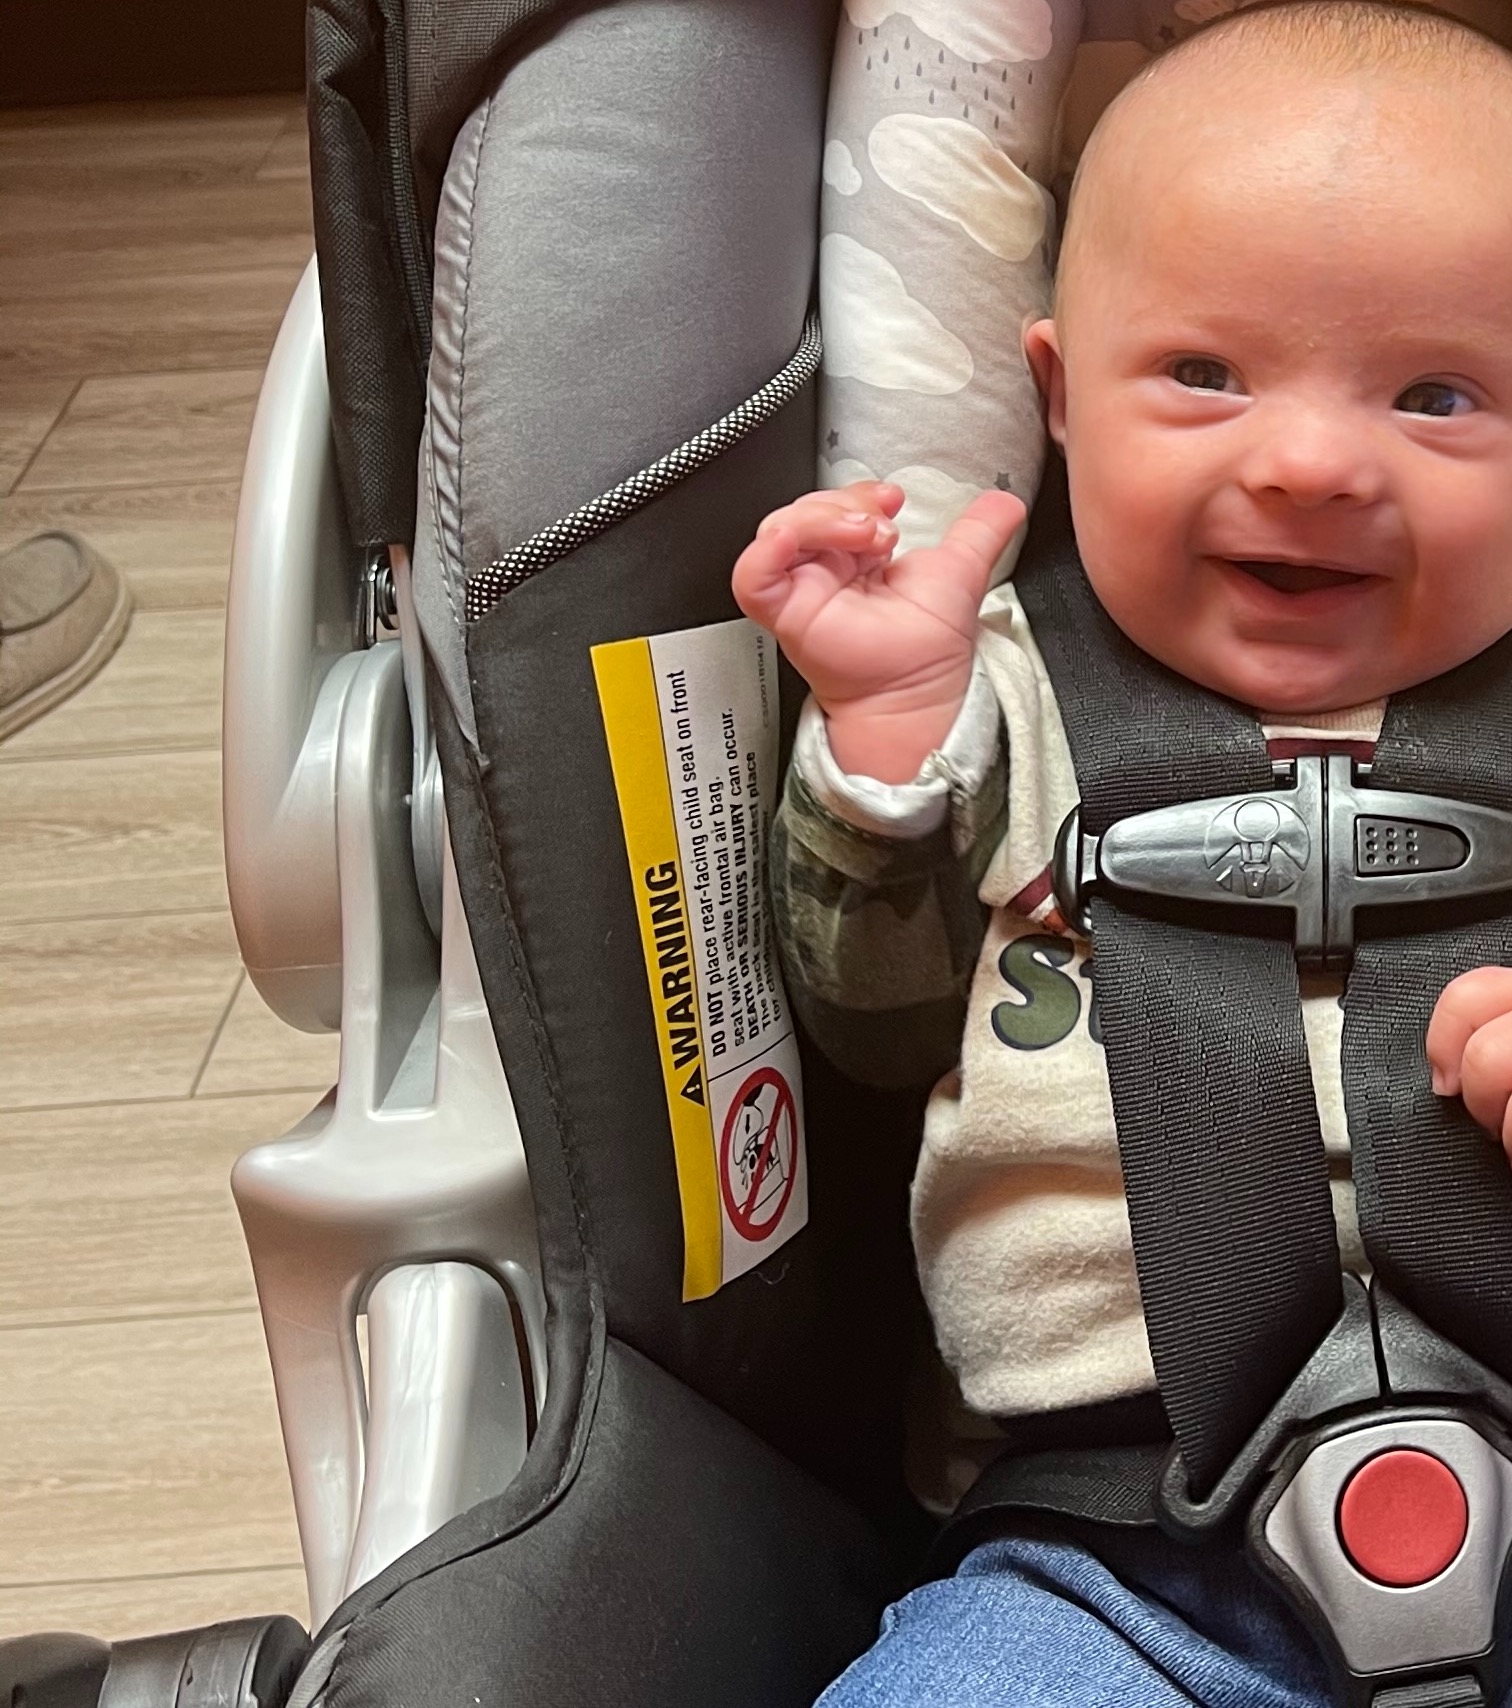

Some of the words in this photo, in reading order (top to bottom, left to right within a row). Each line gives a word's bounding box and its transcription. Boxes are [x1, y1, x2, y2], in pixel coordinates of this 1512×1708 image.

[666, 670, 688, 713] front
[676, 718, 691, 739] on
[722, 708, 738, 760] occur.
[676, 744, 696, 782] seat
[728, 765, 742, 796] can
[746, 752, 759, 798] place
[681, 787, 703, 829] child
[708, 776, 724, 815] bag.
[711, 821, 726, 842] air
[730, 804, 747, 867] INJURY
[690, 834, 715, 932] rear-facing
[714, 847, 732, 905] frontal
[736, 871, 748, 948] SERIOUS
[722, 910, 734, 962] active
[645, 861, 699, 1070] WARNING
[706, 937, 724, 985] place
[739, 952, 749, 977] OR
[752, 952, 764, 995] back
[727, 966, 741, 1006] with
[707, 990, 724, 1027] NOT
[730, 1009, 744, 1046] seat
[743, 981, 759, 1039] DEATH
[760, 998, 771, 1031] The
[711, 1031, 726, 1057] DO
